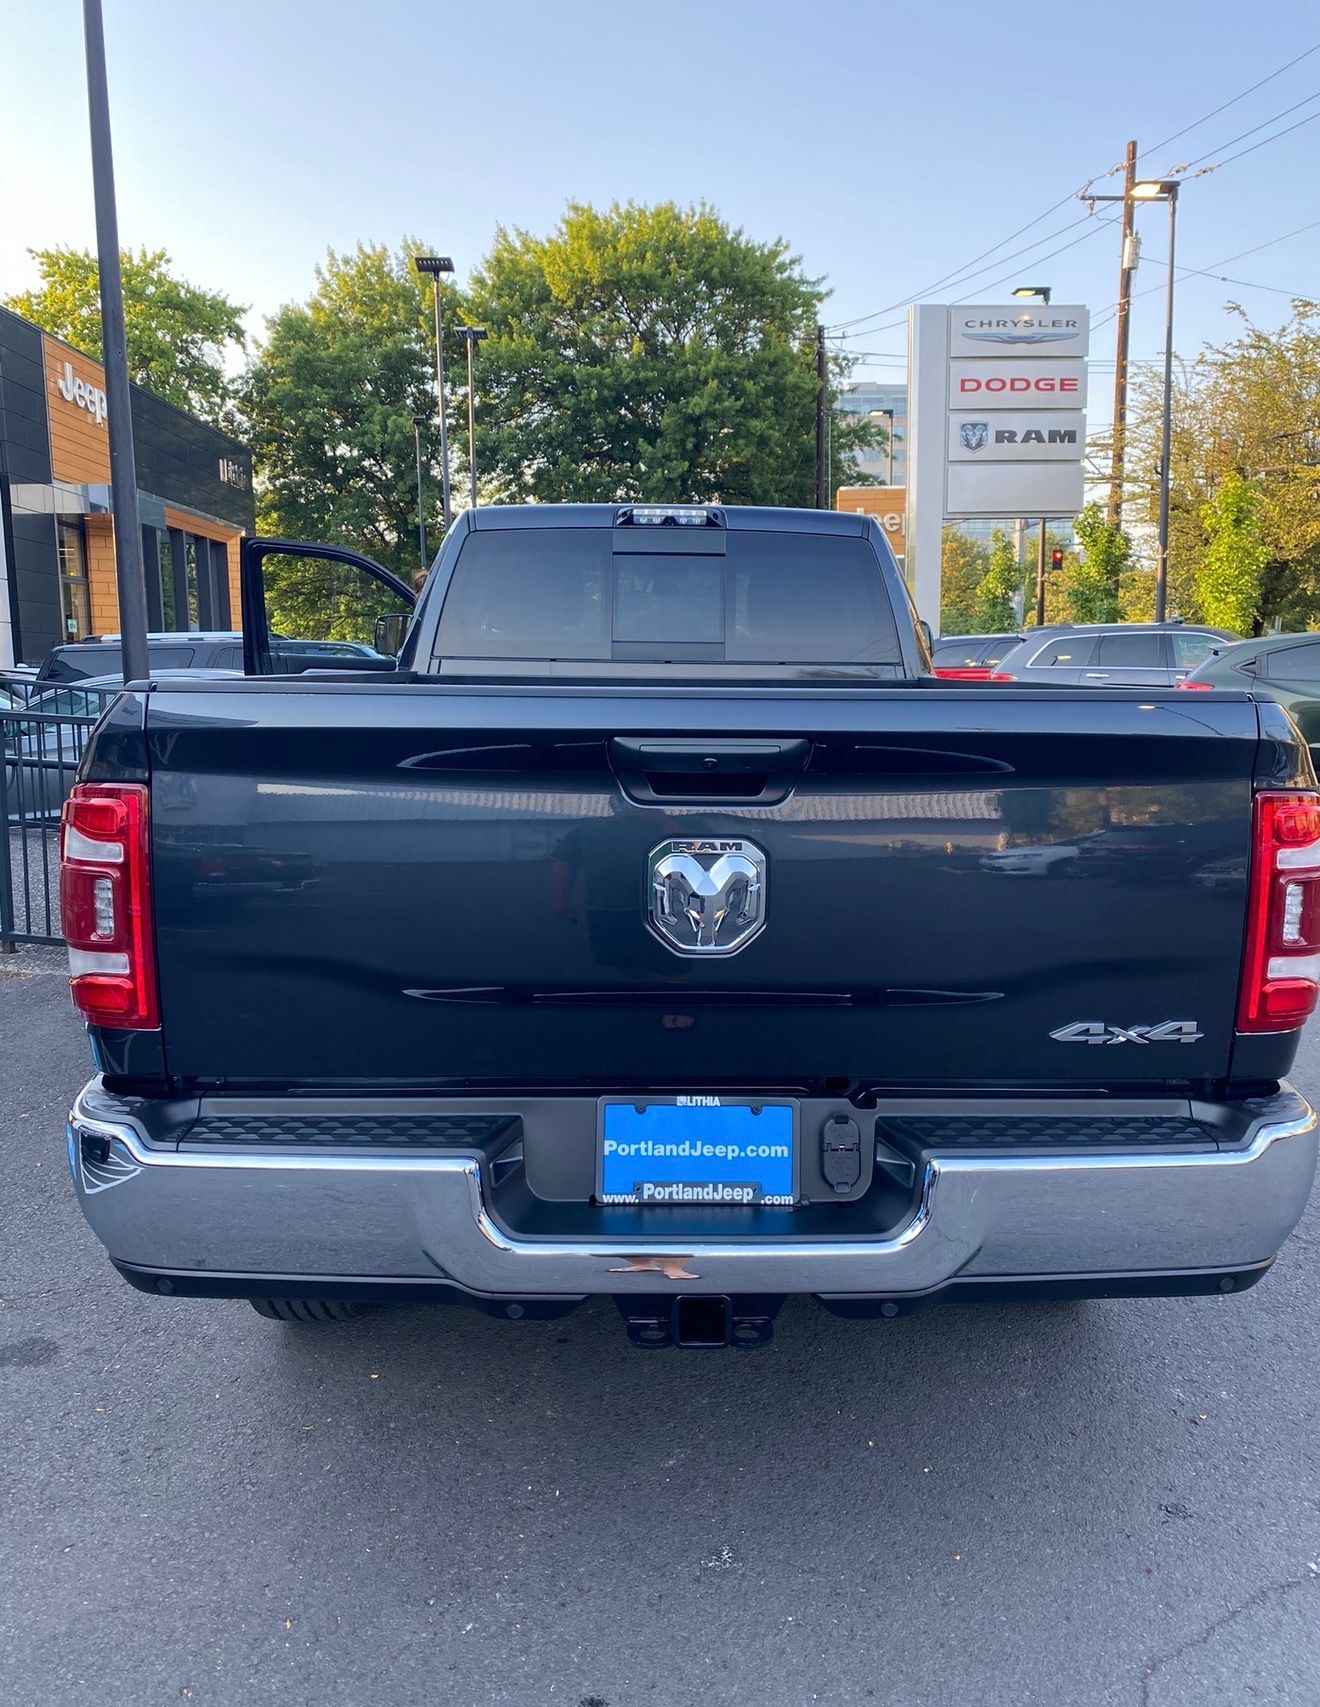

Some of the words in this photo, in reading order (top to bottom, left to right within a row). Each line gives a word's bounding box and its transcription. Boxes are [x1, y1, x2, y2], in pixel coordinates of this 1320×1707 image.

[965, 320, 1078, 328] CHRYSLER
[960, 378, 1079, 392] DODGE
[57, 361, 107, 424] Jeep
[995, 430, 1077, 444] RAM
[672, 841, 743, 852] RAM
[1049, 1020, 1205, 1044] 4x4
[687, 1096, 720, 1106] LITHIA
[604, 1140, 789, 1160] PortlandJeep.com
[602, 1194, 639, 1203] www.
[643, 1183, 753, 1203] PortlandJeep
[760, 1194, 794, 1205] .com
